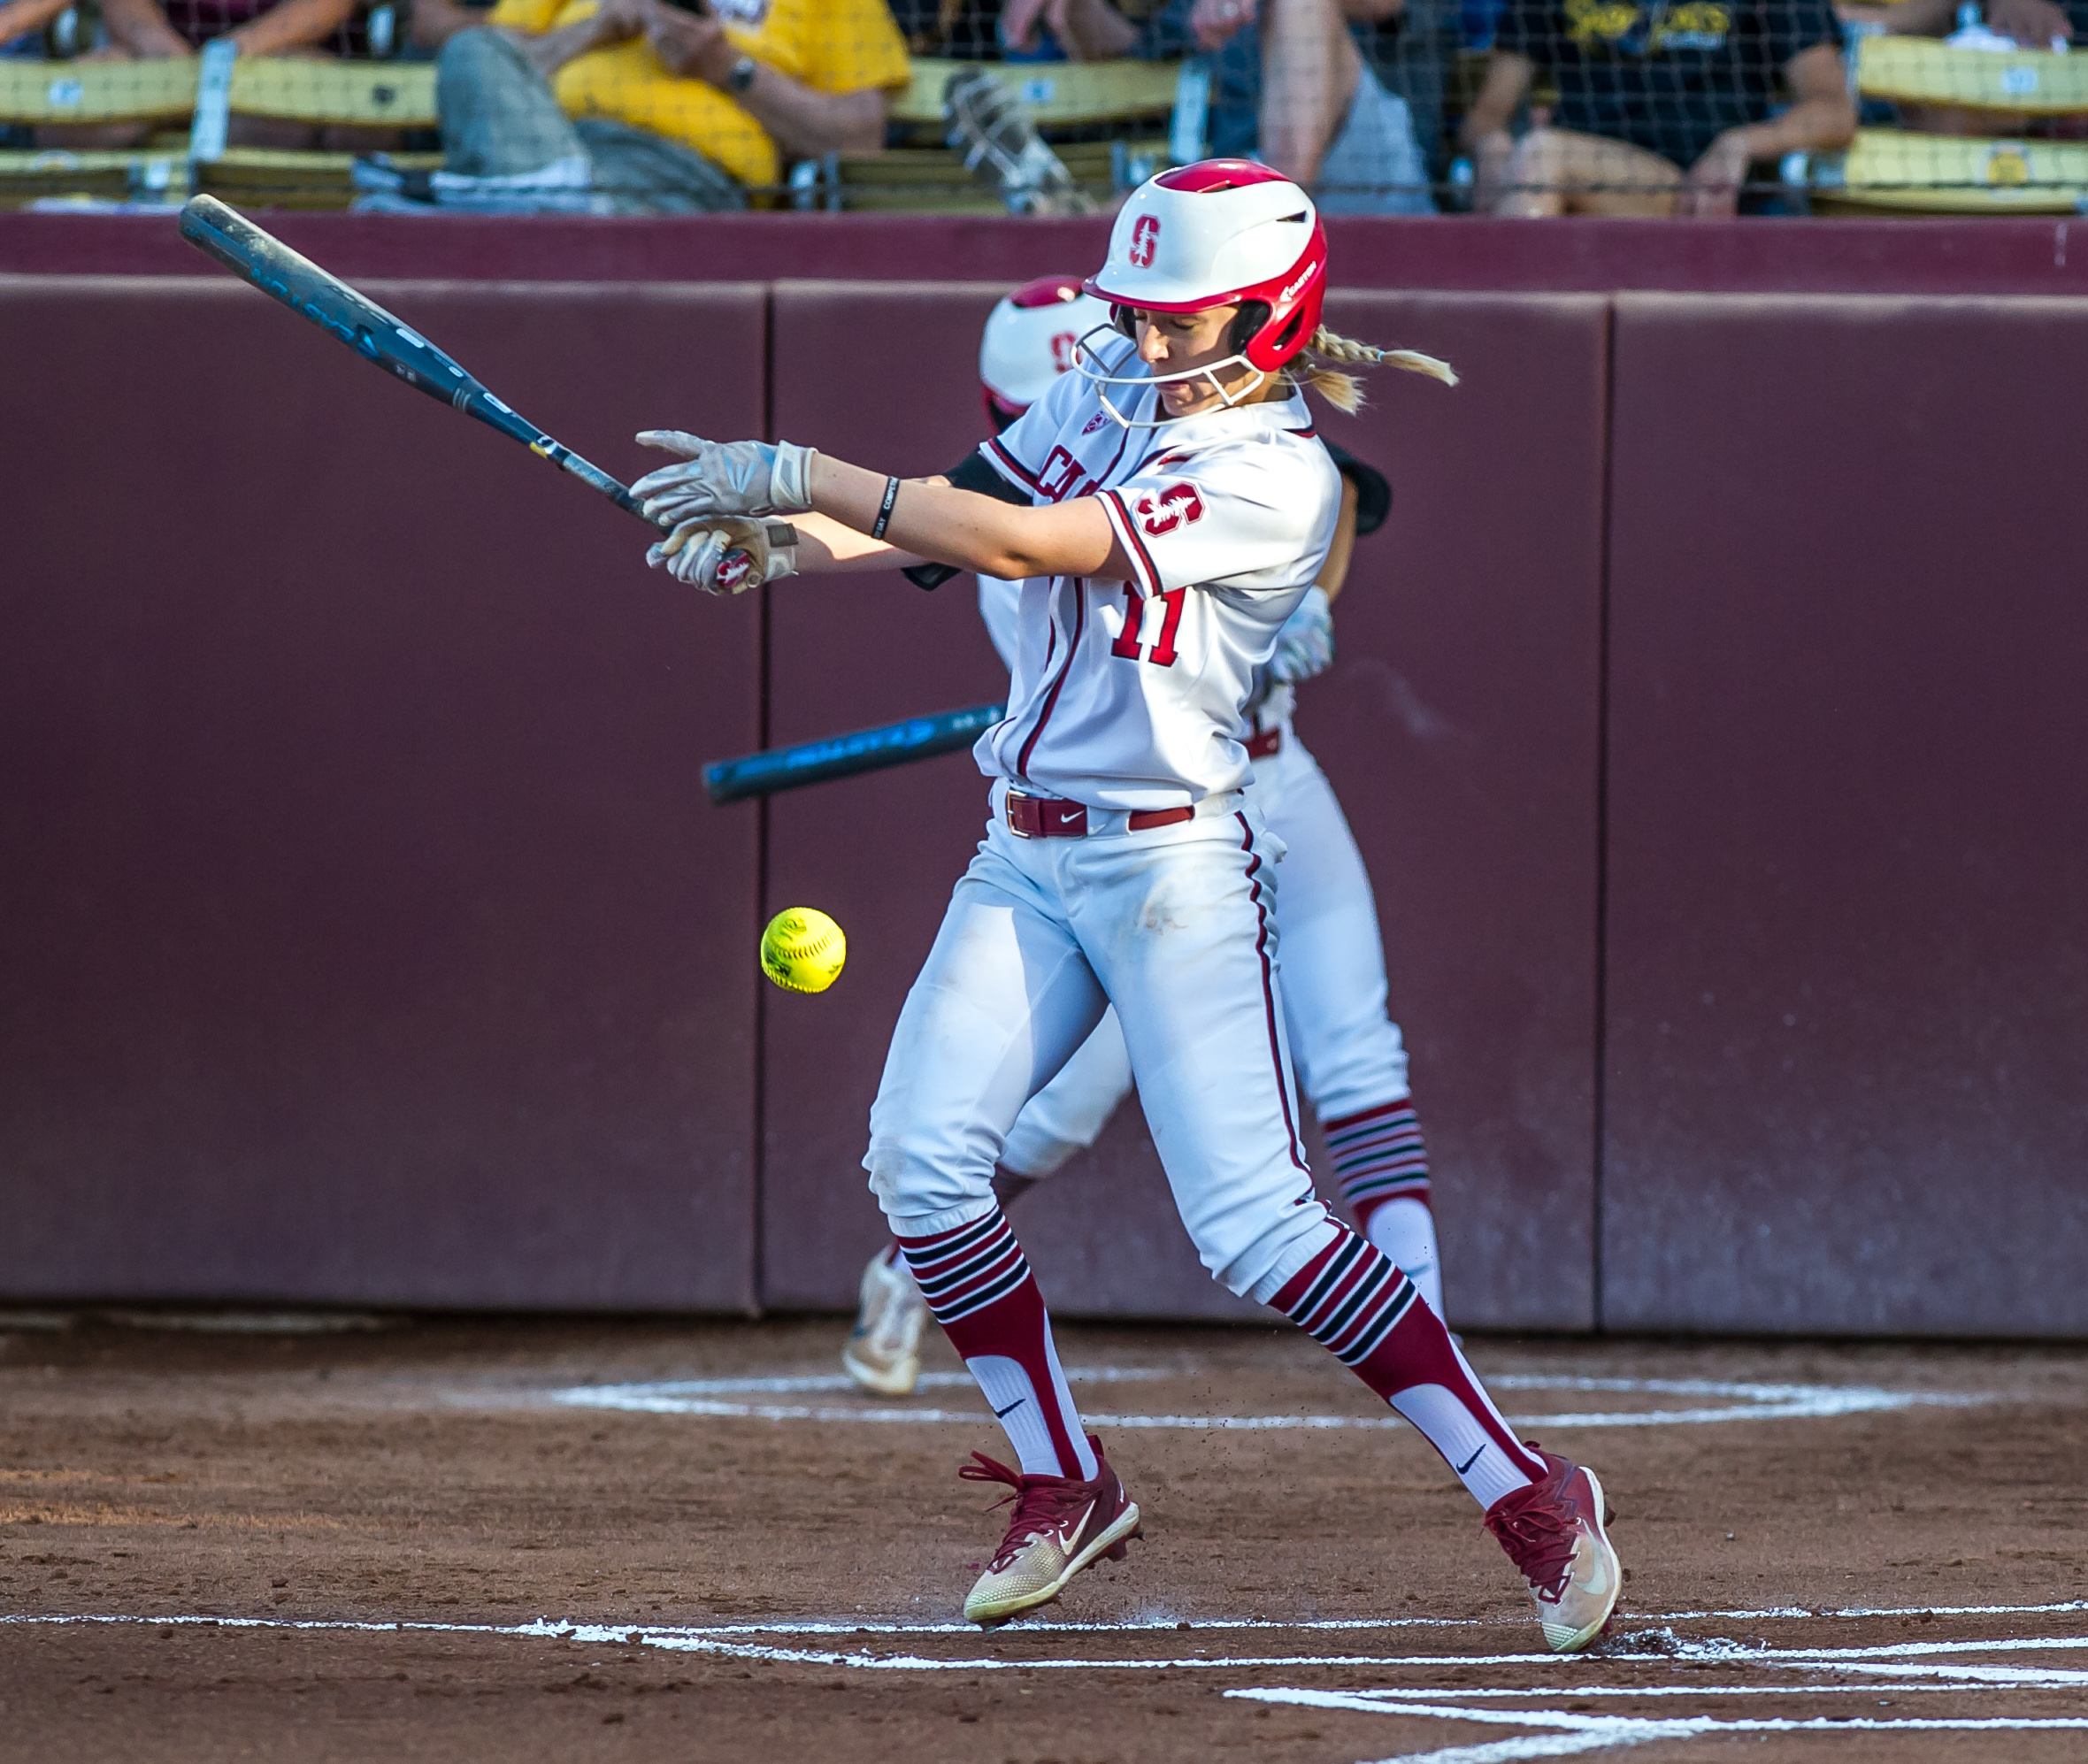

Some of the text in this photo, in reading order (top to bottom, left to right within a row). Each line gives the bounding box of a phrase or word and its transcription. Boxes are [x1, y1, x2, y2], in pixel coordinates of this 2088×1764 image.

[1129, 213, 1161, 268] S
[1288, 260, 1317, 296] EASTON
[1135, 480, 1205, 538] S
[1111, 580, 1186, 667] 11
